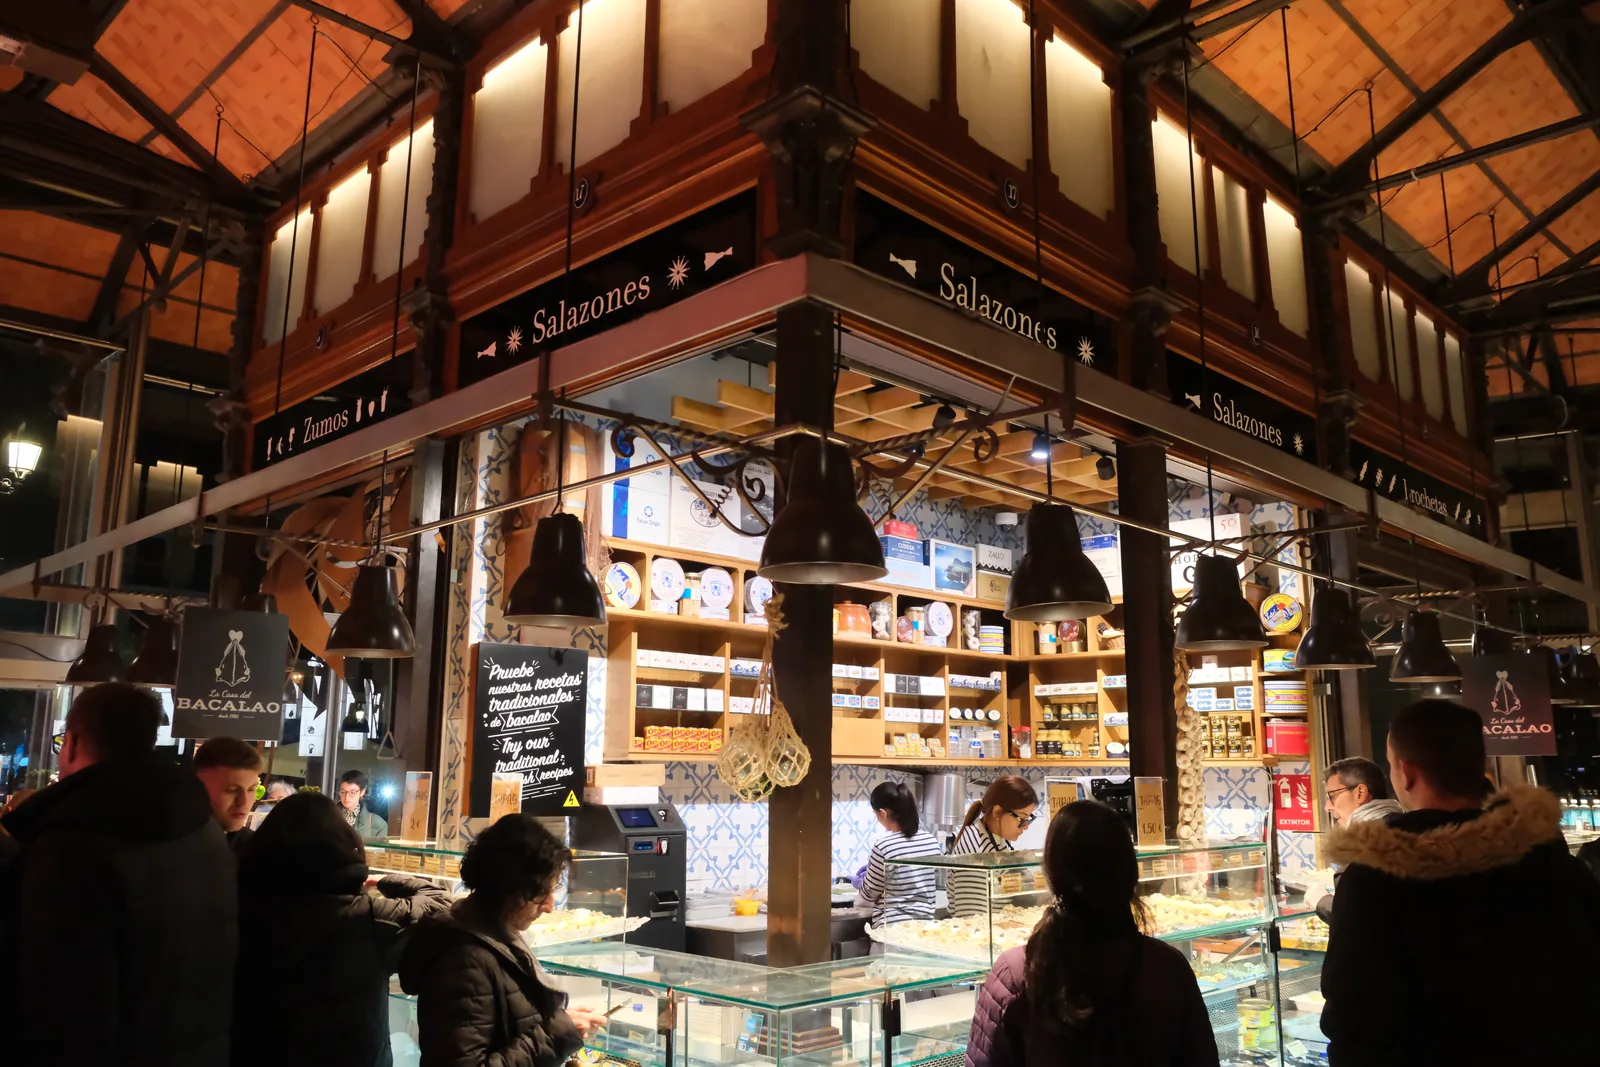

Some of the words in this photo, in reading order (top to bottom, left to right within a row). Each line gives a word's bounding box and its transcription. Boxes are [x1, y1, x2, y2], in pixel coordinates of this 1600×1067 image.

[532, 275, 650, 344] Salazones
[939, 262, 1057, 350] Salazones
[303, 409, 349, 444] Zumos
[1213, 392, 1283, 447] Salazones
[1220, 517, 1237, 532] 50
[988, 550, 1005, 560] ZALLO
[489, 661, 535, 680] Pruebe
[488, 681, 533, 695] nuestras
[534, 672, 582, 691] recetas
[208, 689, 220, 698] La
[221, 689, 239, 698] Casa
[240, 690, 252, 699] del
[488, 688, 574, 712] tradicionales
[176, 698, 280, 713] BACALAO
[489, 716, 501, 728] de
[506, 709, 551, 728] bacalao
[1482, 723, 1552, 734] ACALAO
[502, 737, 523, 760] Try
[525, 736, 551, 750] our
[495, 749, 560, 773] traditional
[540, 766, 574, 781] recipes
[1279, 818, 1311, 826] EXTINTOR
